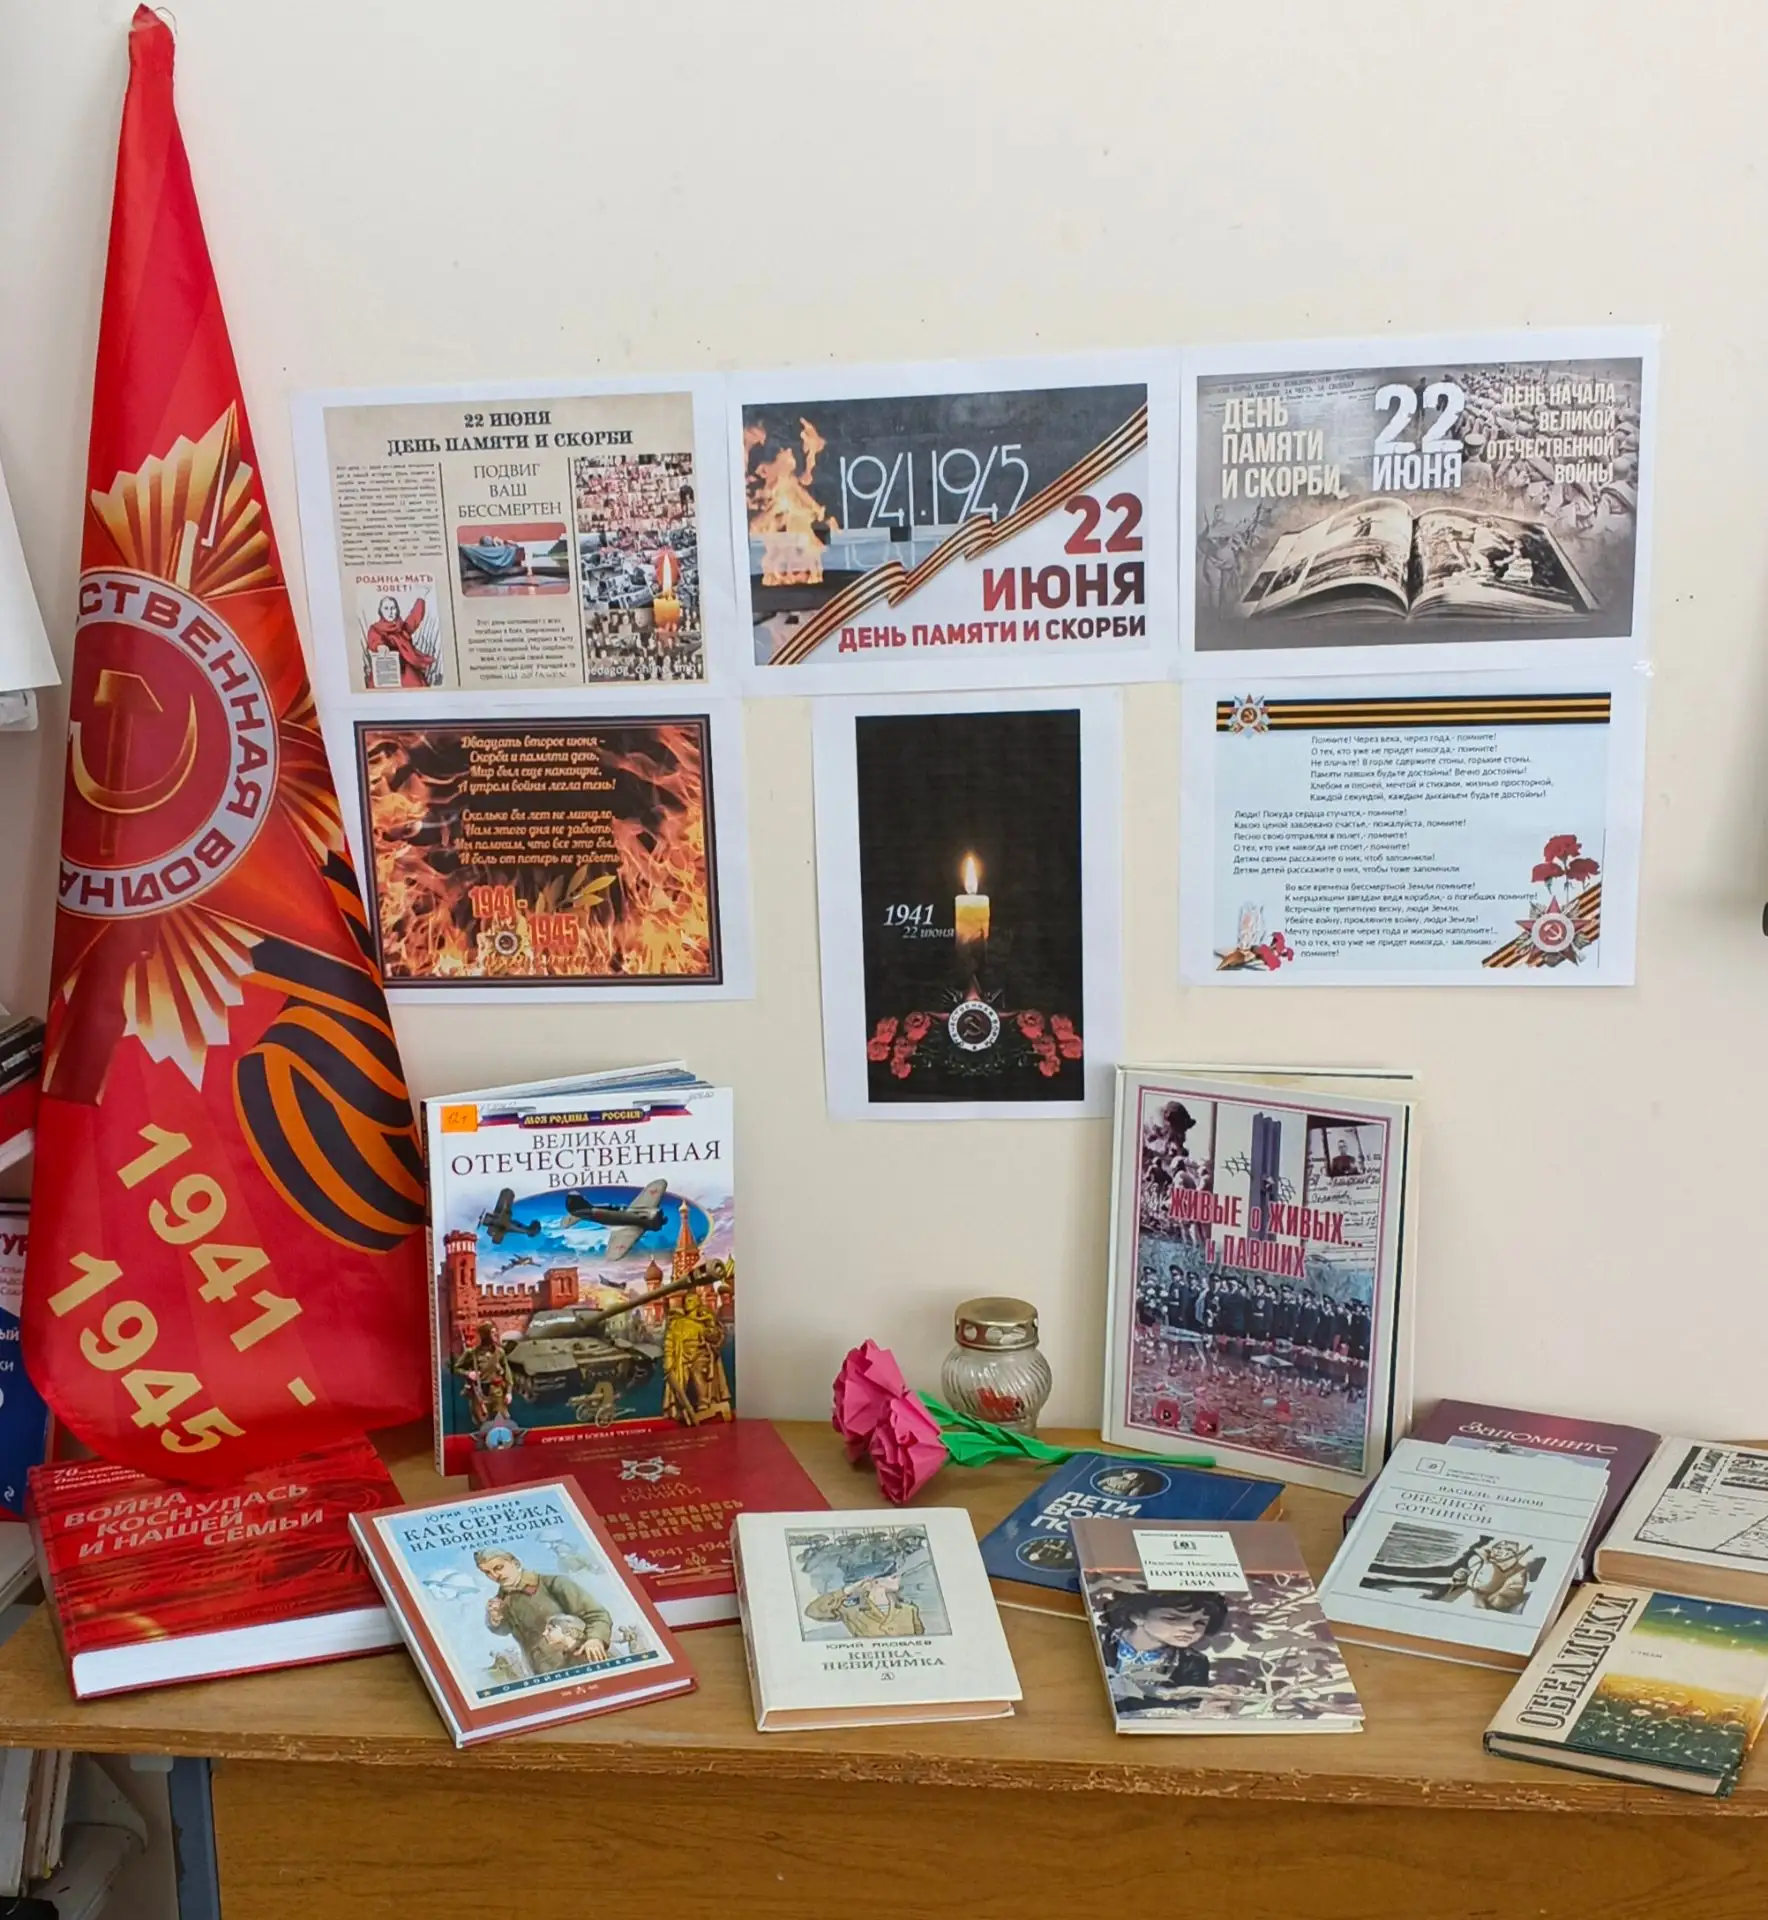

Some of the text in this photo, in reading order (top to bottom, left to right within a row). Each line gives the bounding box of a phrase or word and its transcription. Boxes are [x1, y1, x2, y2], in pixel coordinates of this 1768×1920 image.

[1503, 382, 1616, 407] ДЕНЬ НАЧАЛА
[463, 411, 551, 428] 22 ИЮНЯ
[1222, 395, 1290, 433] ДЕНЬ
[1373, 380, 1465, 456] 22
[1539, 406, 1616, 432] ВЕЛИКОЙ
[388, 430, 633, 456] ДЕНЬ ПАМЯТИ И СКОРБИ
[1222, 429, 1324, 465] ПАМЯТИ
[1487, 434, 1616, 461] ОТЕЧЕСТВЕННОЙ
[472, 463, 541, 479] ПОДВИГ
[1222, 463, 1342, 500] И СКОРБИ
[1371, 452, 1463, 492] ИЮНЯ
[1554, 462, 1615, 485] ВОЙНЫ
[489, 483, 528, 498] ВАШ
[458, 501, 562, 518] БЕССМЕРТЕН
[1063, 492, 1144, 556] 22
[982, 561, 1146, 612] ИЮНЯ
[838, 614, 1147, 653] ДЕНЬ ПАМЯТИ И СКОРБИ
[883, 904, 934, 926] 1941
[527, 912, 580, 949] 1945
[902, 926, 955, 939] 22 июня
[523, 1113, 548, 1126] МОЯ
[549, 1111, 590, 1126] РОДИНА
[601, 1109, 642, 1122] РОССИЯ
[532, 1129, 637, 1150] ВЕЛИКАЯ
[451, 1140, 722, 1176] ОТЕЧЕСТВЕННАЯ
[548, 1168, 630, 1188] ВОЙНА
[1168, 1186, 1244, 1228] ЖИВЫЕ
[1267, 1203, 1364, 1250] ЖИВЫХ...
[116, 1122, 303, 1353] 1941
[1222, 1234, 1307, 1281] ПАВШИХ
[47, 1251, 247, 1454] 1945
[620, 1487, 703, 1503] ПАМЯТИ
[626, 1482, 689, 1494] КНИГА
[64, 1490, 188, 1529] ВОЙНА
[95, 1484, 309, 1539] КОСНУЛАСЬ
[638, 1499, 744, 1521] СРАЖАЛИСЬ
[1053, 1491, 1143, 1517] ДЕТИ
[1394, 1501, 1494, 1525] СОТНИКОВ
[78, 1510, 245, 1559] И НАШЕЙ
[202, 1509, 325, 1548] СЕМЬИ
[403, 1503, 560, 1543] КАК СЕРЁЖА
[410, 1515, 565, 1553] НА ВОЙНУ ХОДИЛ
[612, 1526, 684, 1542] ФРОНТЕ
[624, 1512, 726, 1532] ЗА РОДИНУ
[647, 1545, 682, 1559] 1941
[821, 1658, 945, 1672] НЕВИДИМКА
[1516, 1592, 1640, 1731] ОБЕЛИСКИ
